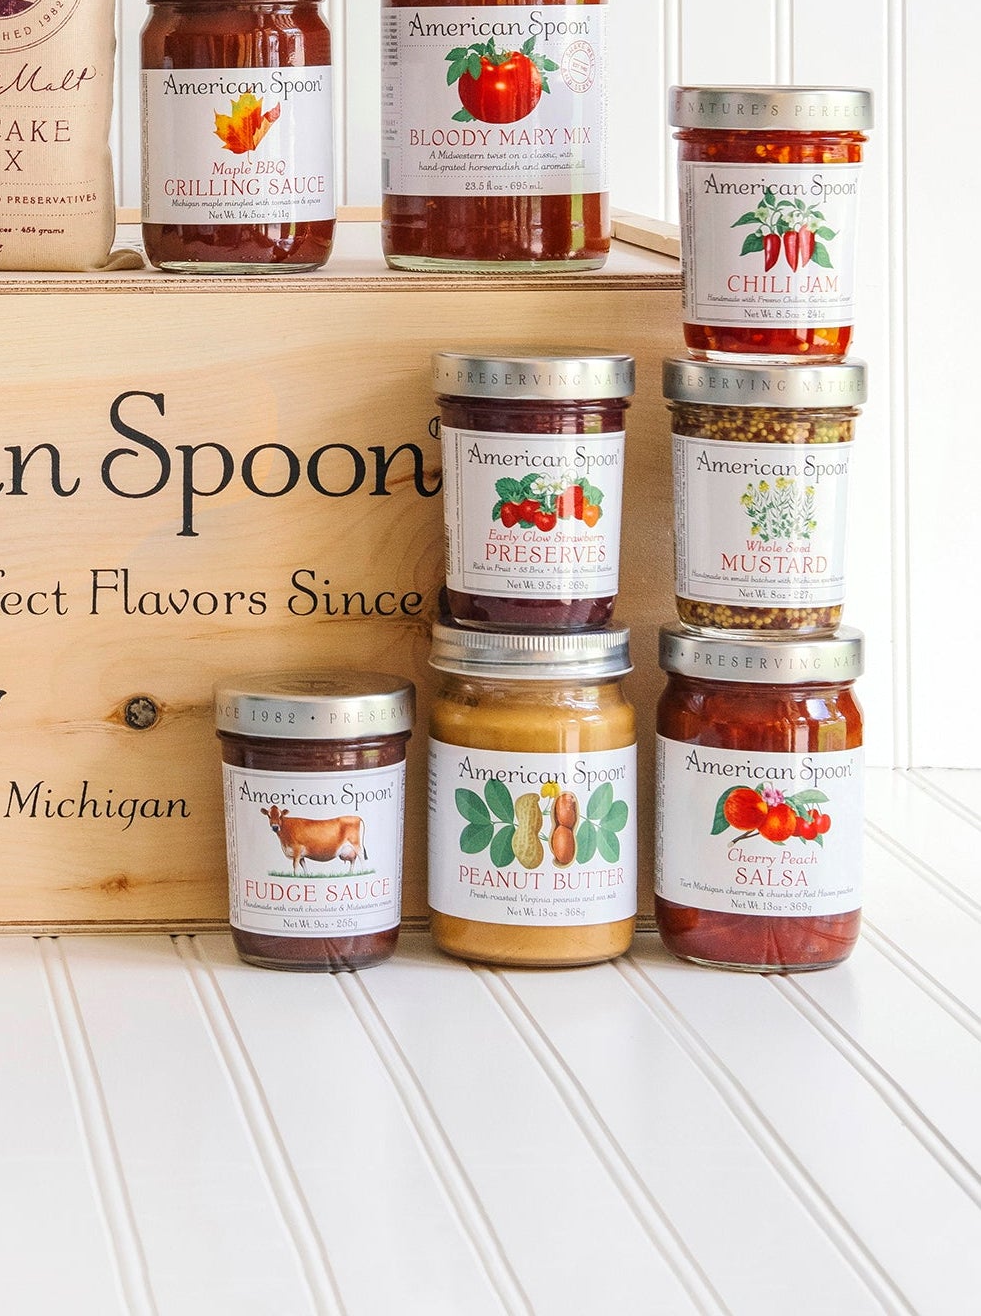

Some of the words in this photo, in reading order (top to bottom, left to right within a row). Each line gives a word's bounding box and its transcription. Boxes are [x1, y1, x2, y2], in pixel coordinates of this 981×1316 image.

[38, 0, 64, 28] 1982
[408, 12, 524, 37] American
[163, 73, 267, 95] American
[410, 128, 494, 146] BLOODY
[498, 128, 558, 146] MARY
[563, 127, 591, 144] MIX
[212, 161, 252, 178] Maple
[255, 160, 286, 175] BBQ
[164, 178, 261, 197] GRILLING
[268, 175, 325, 195] SAUCE
[703, 173, 808, 196] American
[7, 192, 97, 205] PRESERVATIVES
[21, 226, 36, 234] 454
[38, 227, 65, 236] grams
[727, 274, 791, 294] CHILI
[799, 275, 838, 294] JAM
[457, 372, 581, 386] PRESERVING
[468, 443, 569, 468] American
[696, 450, 799, 476] American
[488, 528, 519, 544] Early
[522, 530, 551, 543] Glow
[746, 540, 782, 553] Whole
[485, 543, 607, 564] PRESERVES
[721, 553, 828, 574] MUSTARD
[89, 568, 268, 617] Flavors
[287, 568, 423, 617] Since
[693, 652, 822, 670] PRESERVING
[251, 710, 297, 724] 1982
[458, 756, 569, 785] American
[686, 750, 796, 780] American
[239, 781, 339, 806] American
[3, 779, 191, 833] Michigan
[727, 848, 777, 867] Cherry
[781, 851, 818, 865] Peach
[459, 865, 545, 891] PEANUT
[554, 867, 625, 890] BUTTER
[735, 867, 809, 887] SALSA
[245, 879, 317, 903] FUDGE
[325, 877, 391, 902] SAUCE
